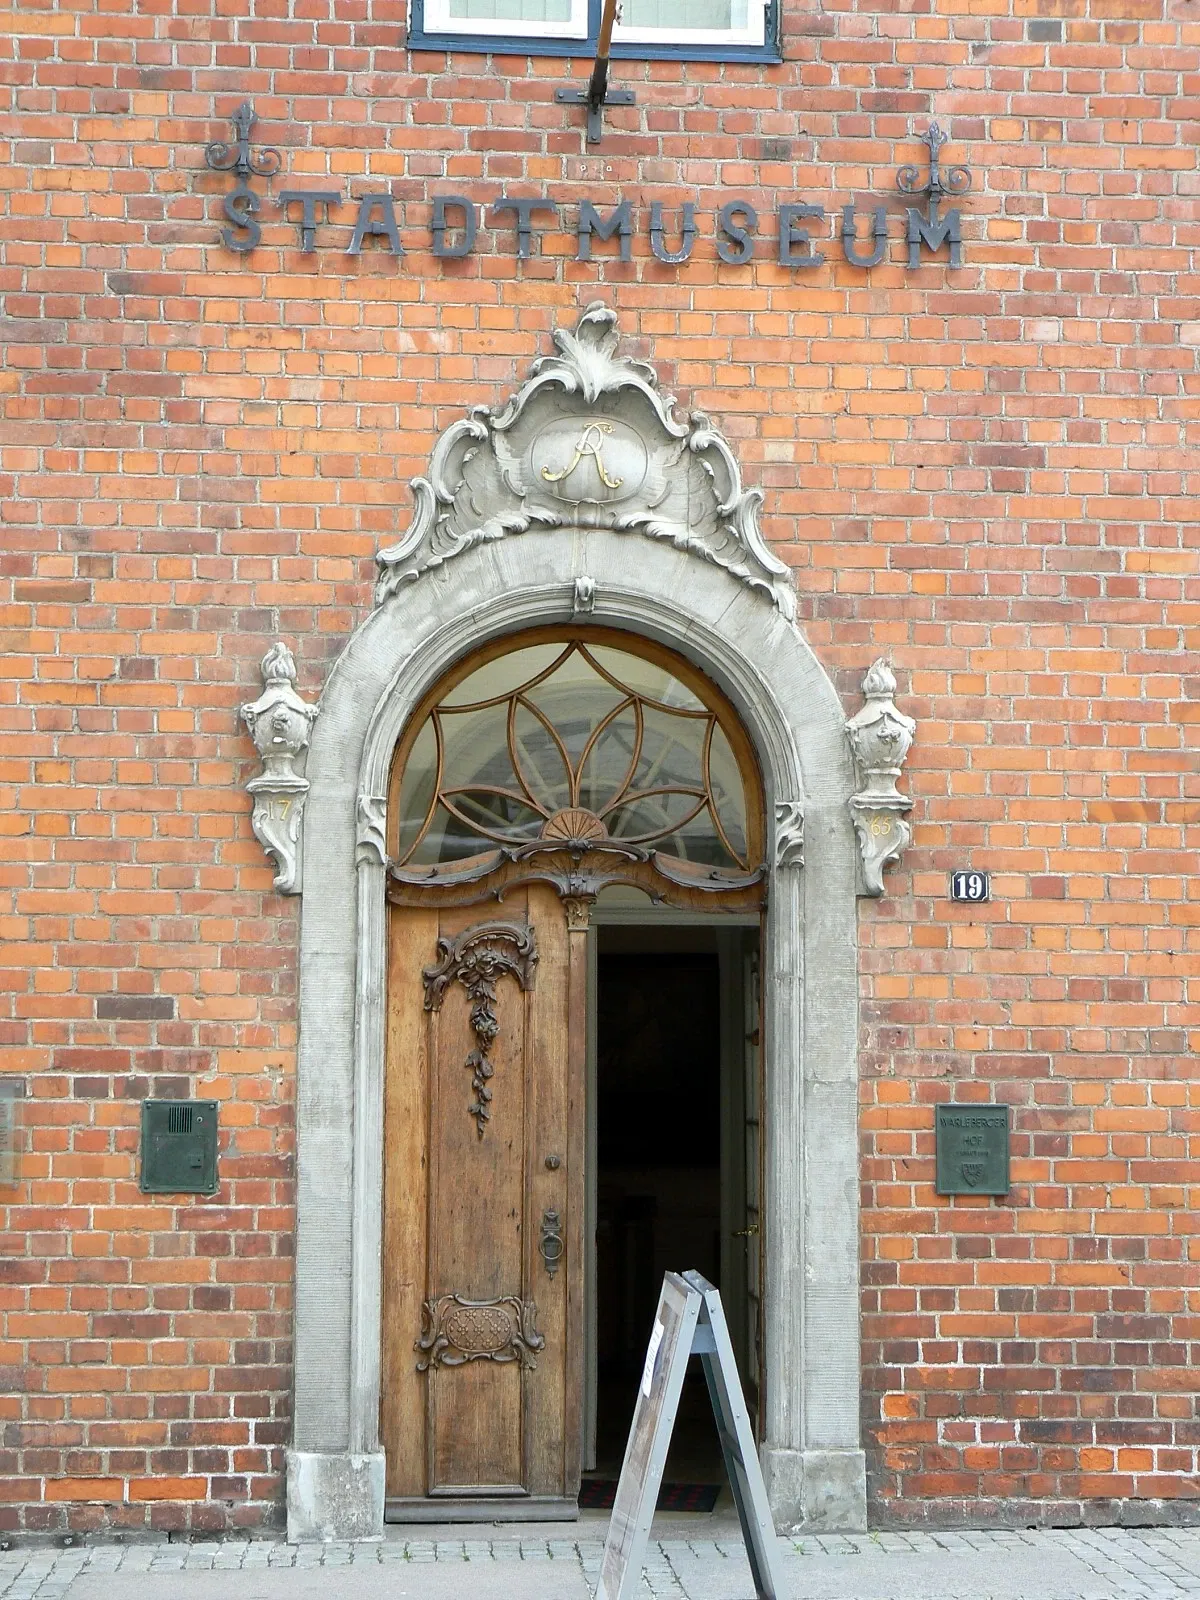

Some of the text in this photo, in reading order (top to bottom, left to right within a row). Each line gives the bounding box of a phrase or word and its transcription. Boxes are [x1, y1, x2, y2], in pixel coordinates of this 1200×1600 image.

[220, 188, 963, 268] STADTMUSEUM
[957, 874, 982, 899] 19
[963, 1135, 983, 1146] HOF
